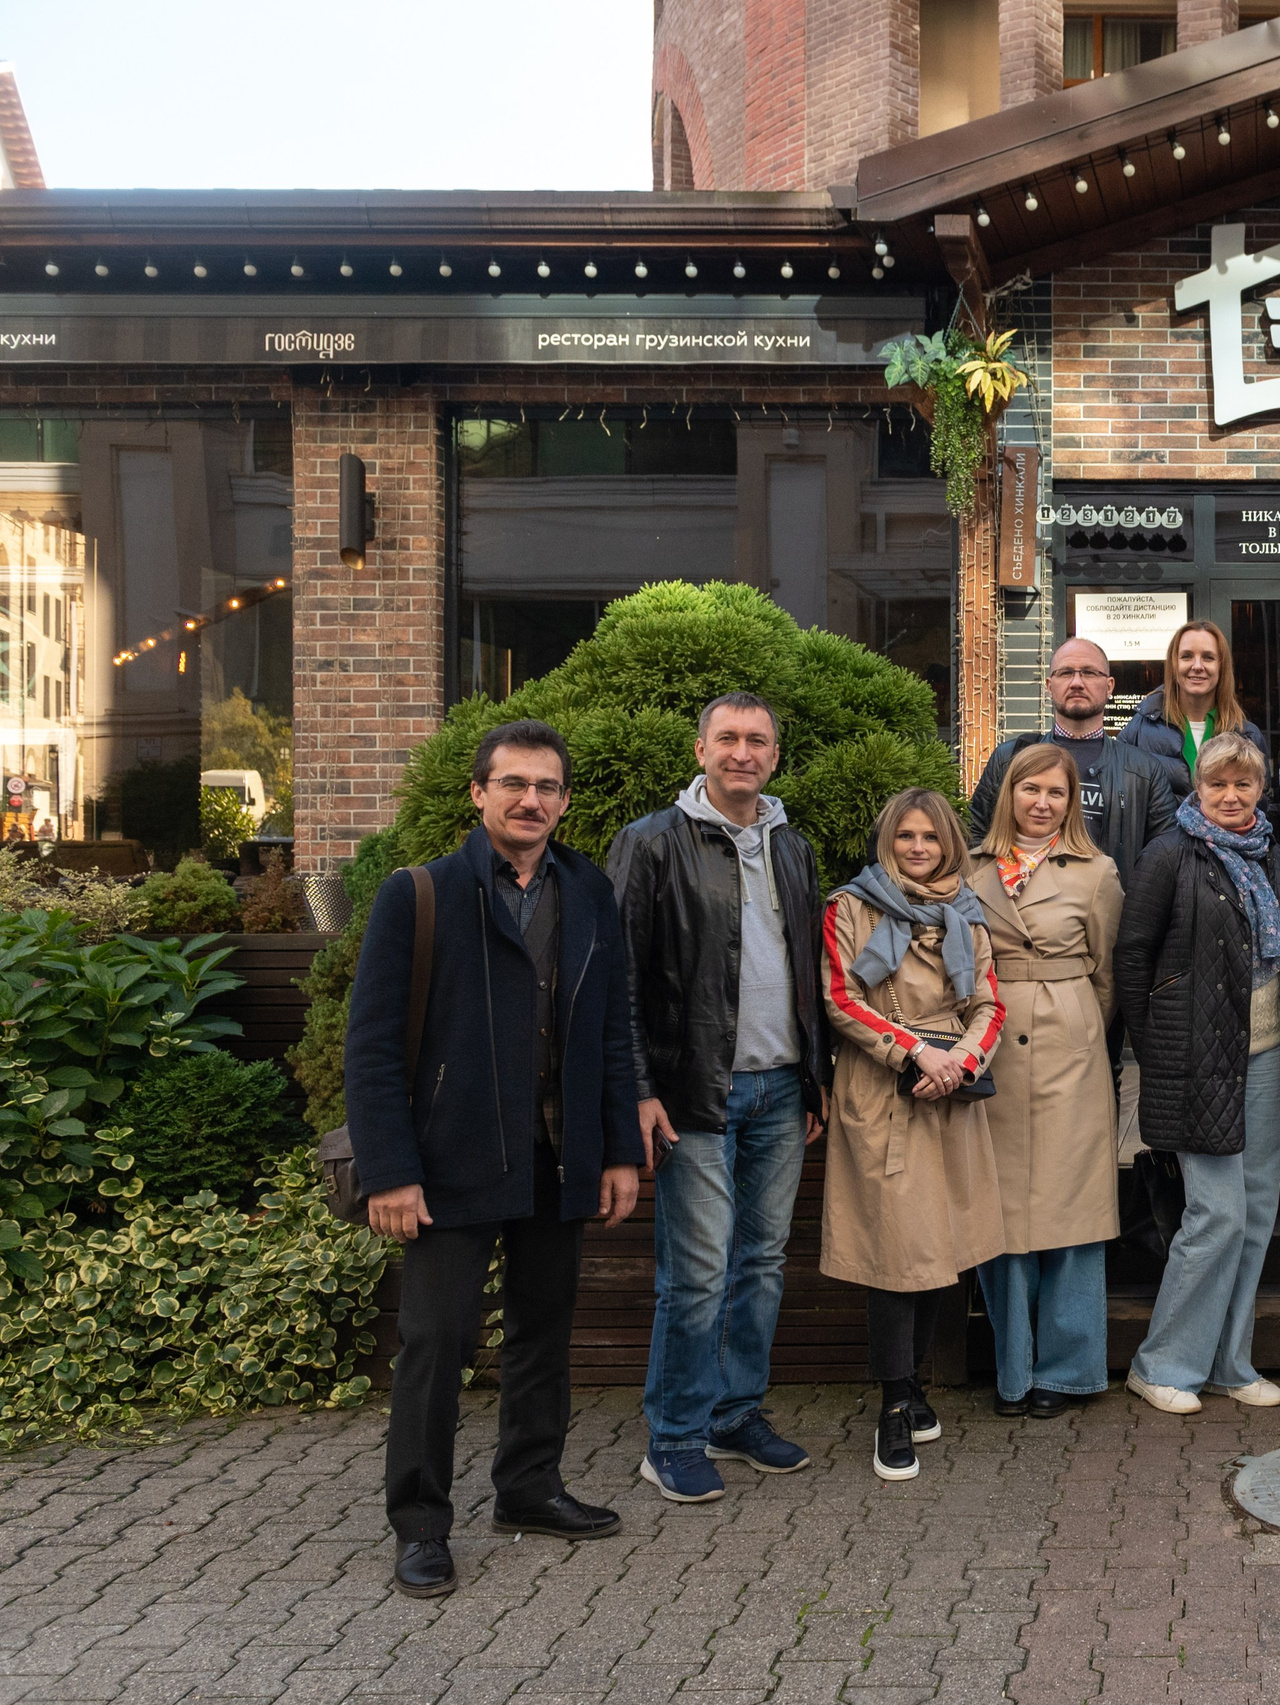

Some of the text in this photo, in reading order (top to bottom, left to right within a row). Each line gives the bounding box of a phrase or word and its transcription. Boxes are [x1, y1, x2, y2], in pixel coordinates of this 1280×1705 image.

[0, 333, 56, 349] кухни
[538, 331, 811, 350] ресторан грузинской кухни
[1012, 452, 1026, 580] СЪЕДЕНО ХИНКАЛИ
[1268, 527, 1277, 538] В
[1107, 595, 1155, 603] ПОЖАЛУЙСТА,
[1086, 604, 1176, 612] СОБЛЮДАЙТЕ ДИСТАНЦИЮ
